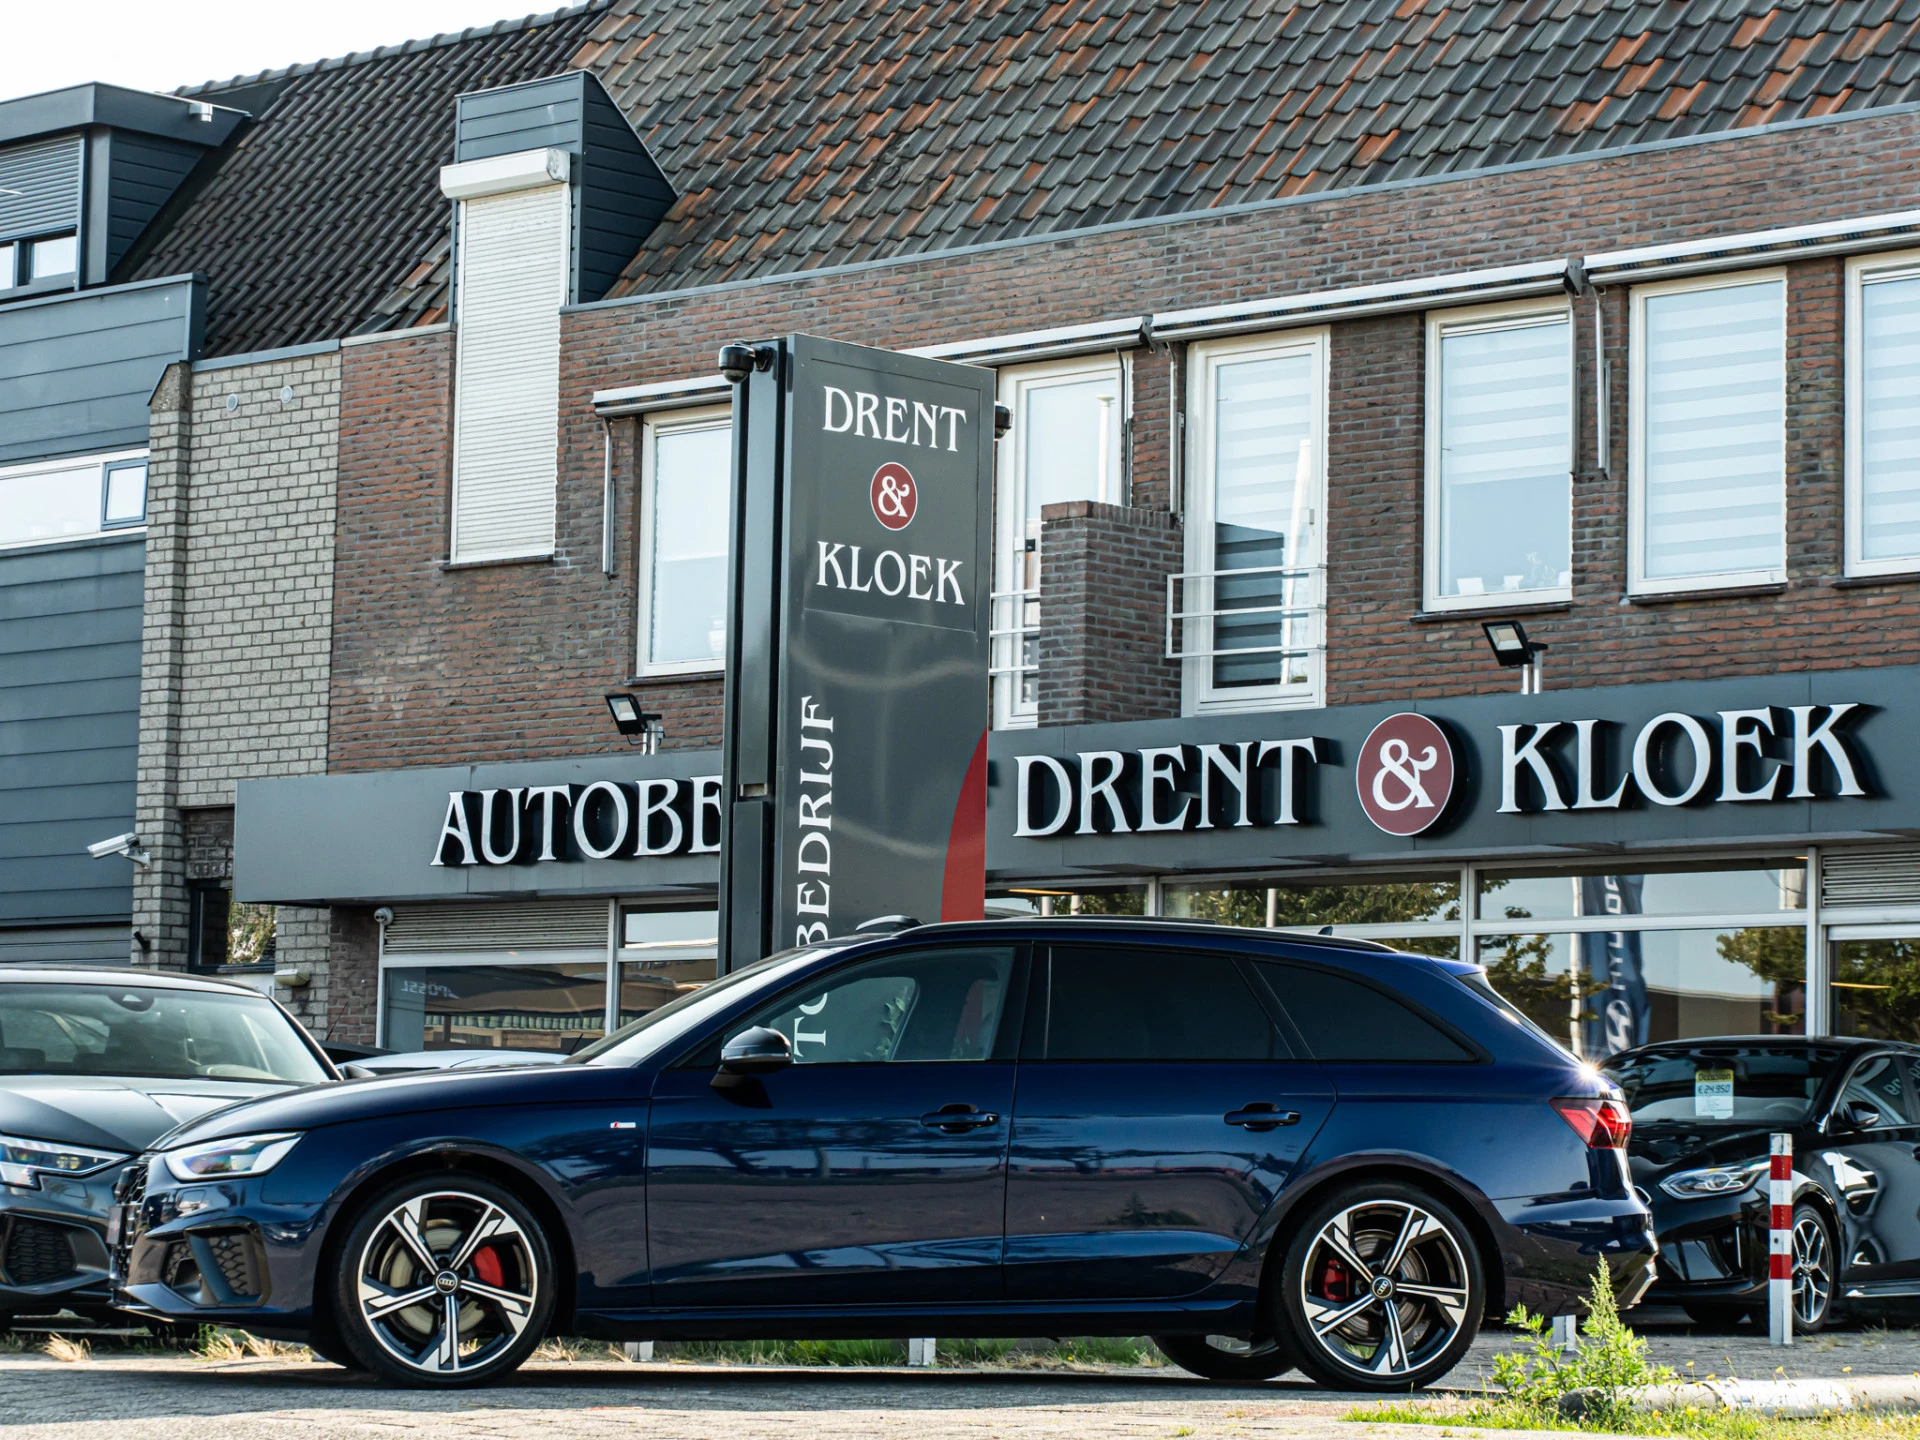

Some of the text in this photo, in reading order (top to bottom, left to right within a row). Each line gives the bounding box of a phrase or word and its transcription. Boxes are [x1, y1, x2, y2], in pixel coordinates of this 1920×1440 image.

[823, 386, 967, 452] DRENT
[878, 475, 909, 518] &
[816, 541, 965, 605] KLOEK
[430, 703, 1866, 866] AUTOBE DRENT & KLOEK
